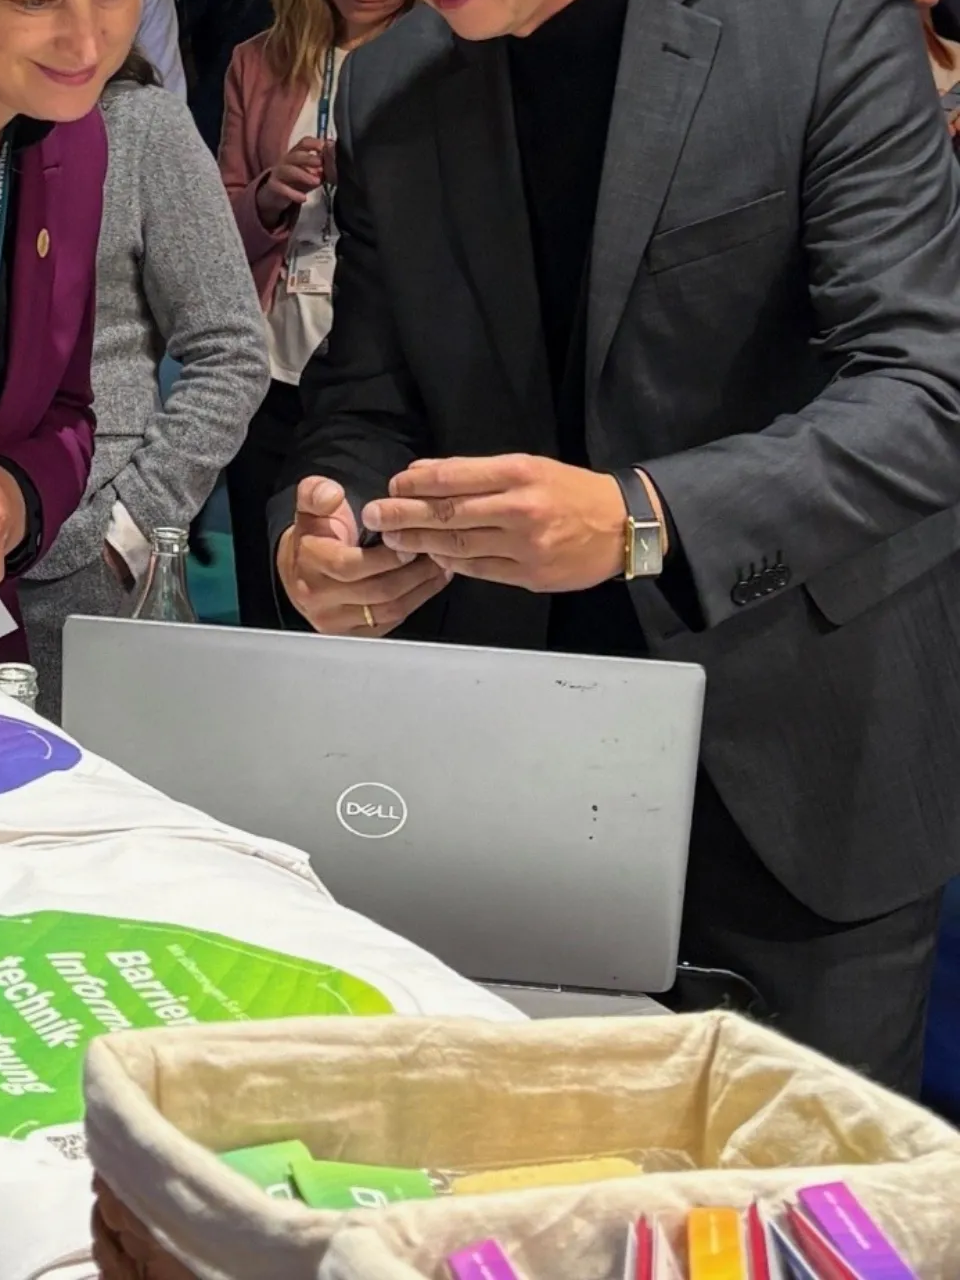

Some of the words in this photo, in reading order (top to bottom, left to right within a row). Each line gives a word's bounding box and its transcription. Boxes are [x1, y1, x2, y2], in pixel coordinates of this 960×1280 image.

[346, 801, 401, 820] DELL
[45, 952, 133, 1033] Inform
[105, 950, 201, 1027] Barrier
